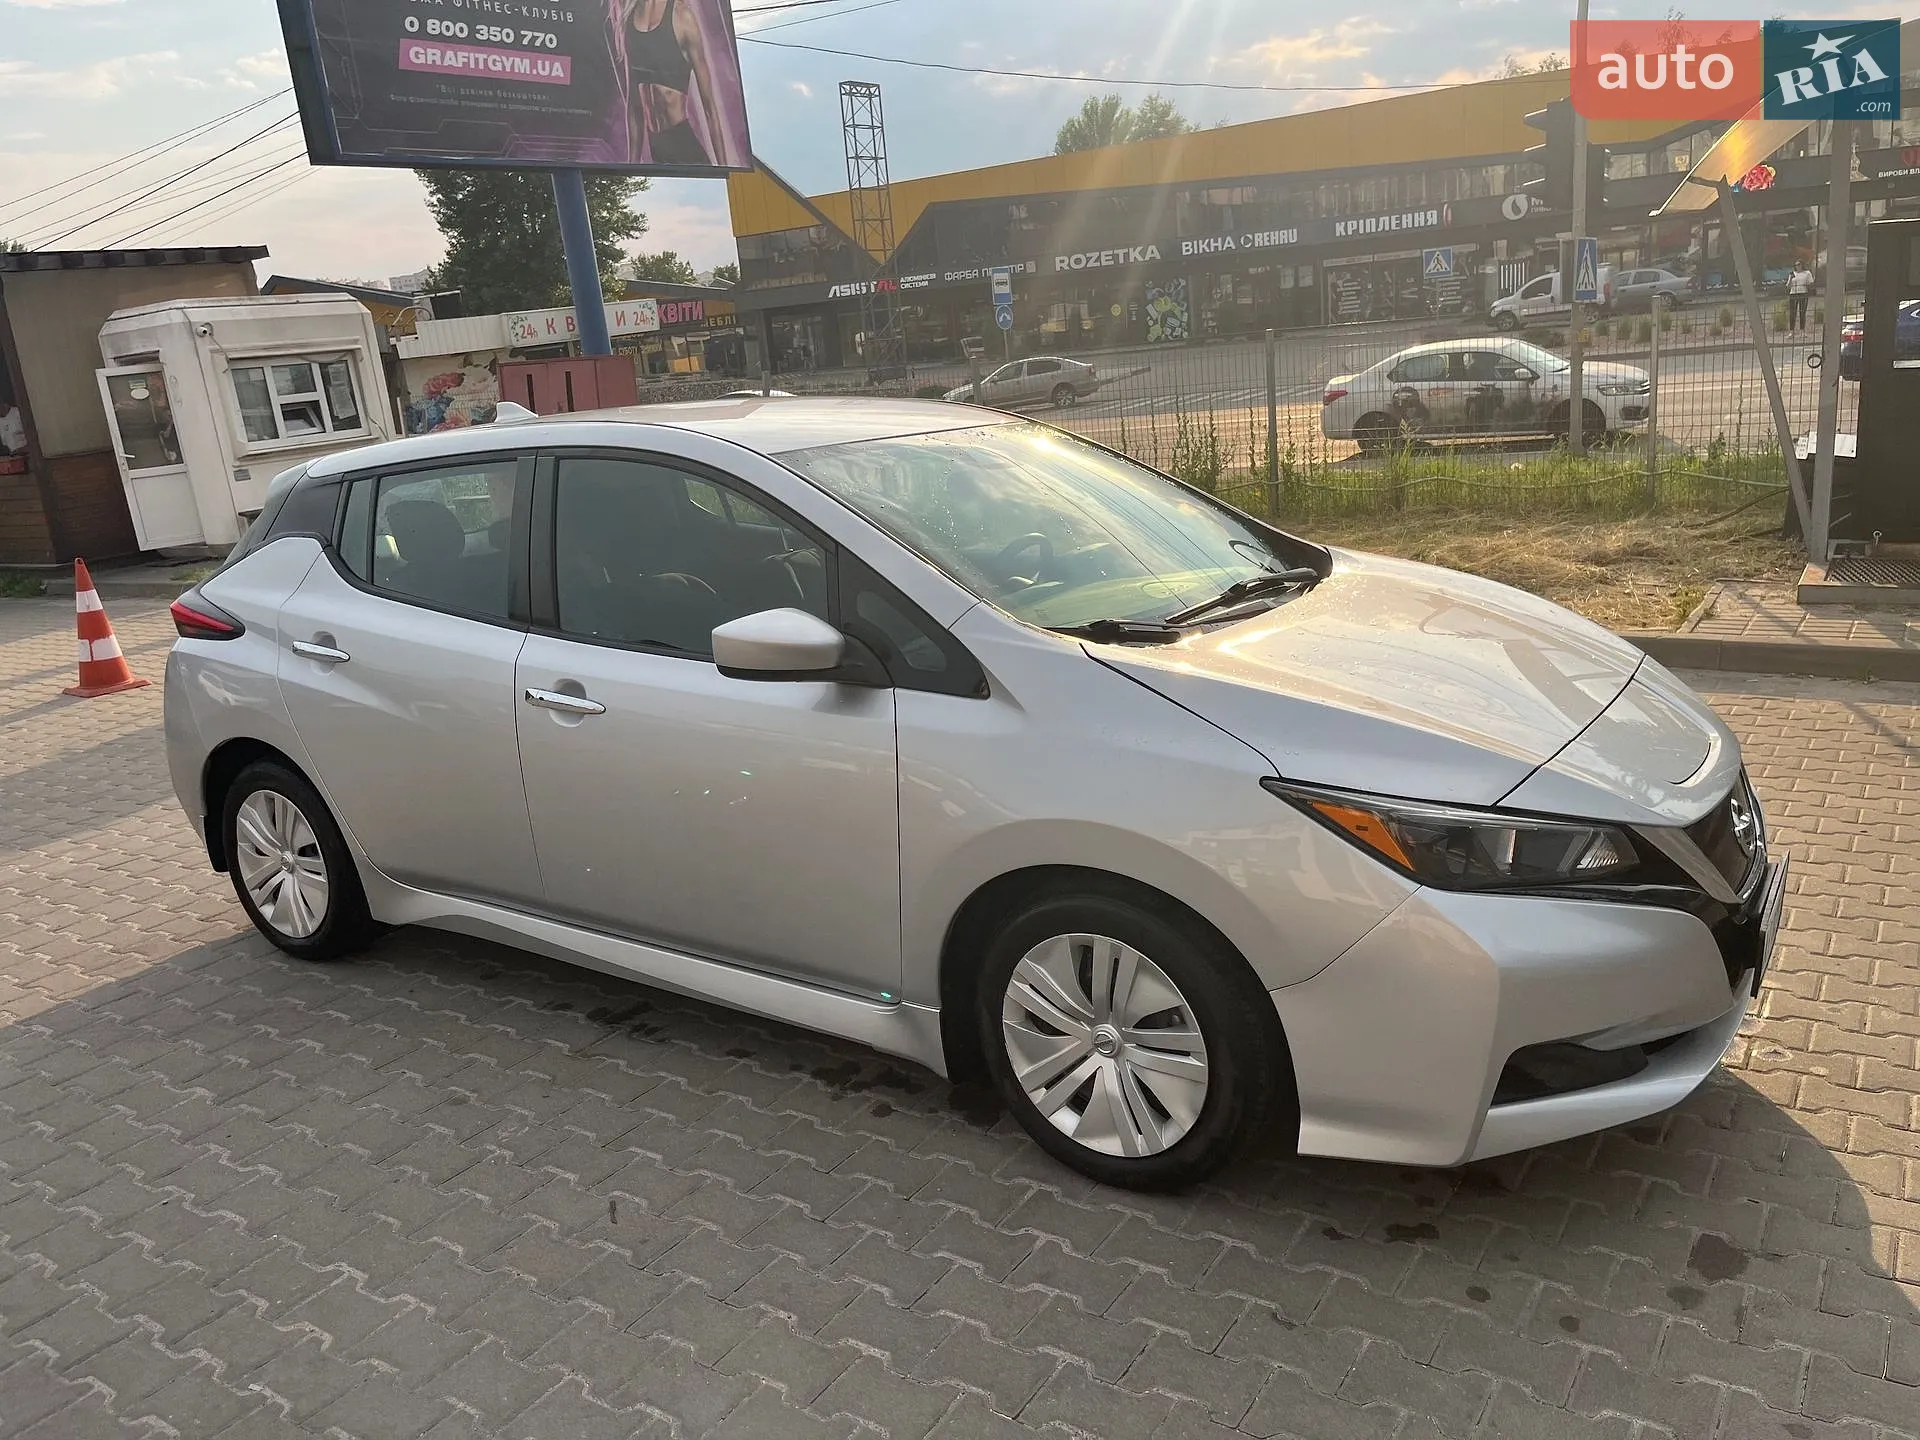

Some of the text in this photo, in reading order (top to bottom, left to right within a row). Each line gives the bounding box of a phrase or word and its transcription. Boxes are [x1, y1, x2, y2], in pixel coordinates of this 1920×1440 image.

[453, 0, 574, 22] ФІТНЕС-КЛУБІВ
[404, 16, 558, 49] 0 800 350 770
[408, 46, 564, 77] GRAFITGYM.UA
[1335, 210, 1438, 237] КРІПЛЕННЯ
[1181, 236, 1236, 255] ВІКНА
[1254, 228, 1298, 248] REHAU
[1055, 244, 1161, 271] ROZETKA
[944, 268, 979, 281] ФАРБА
[657, 300, 703, 324] КВІТИ
